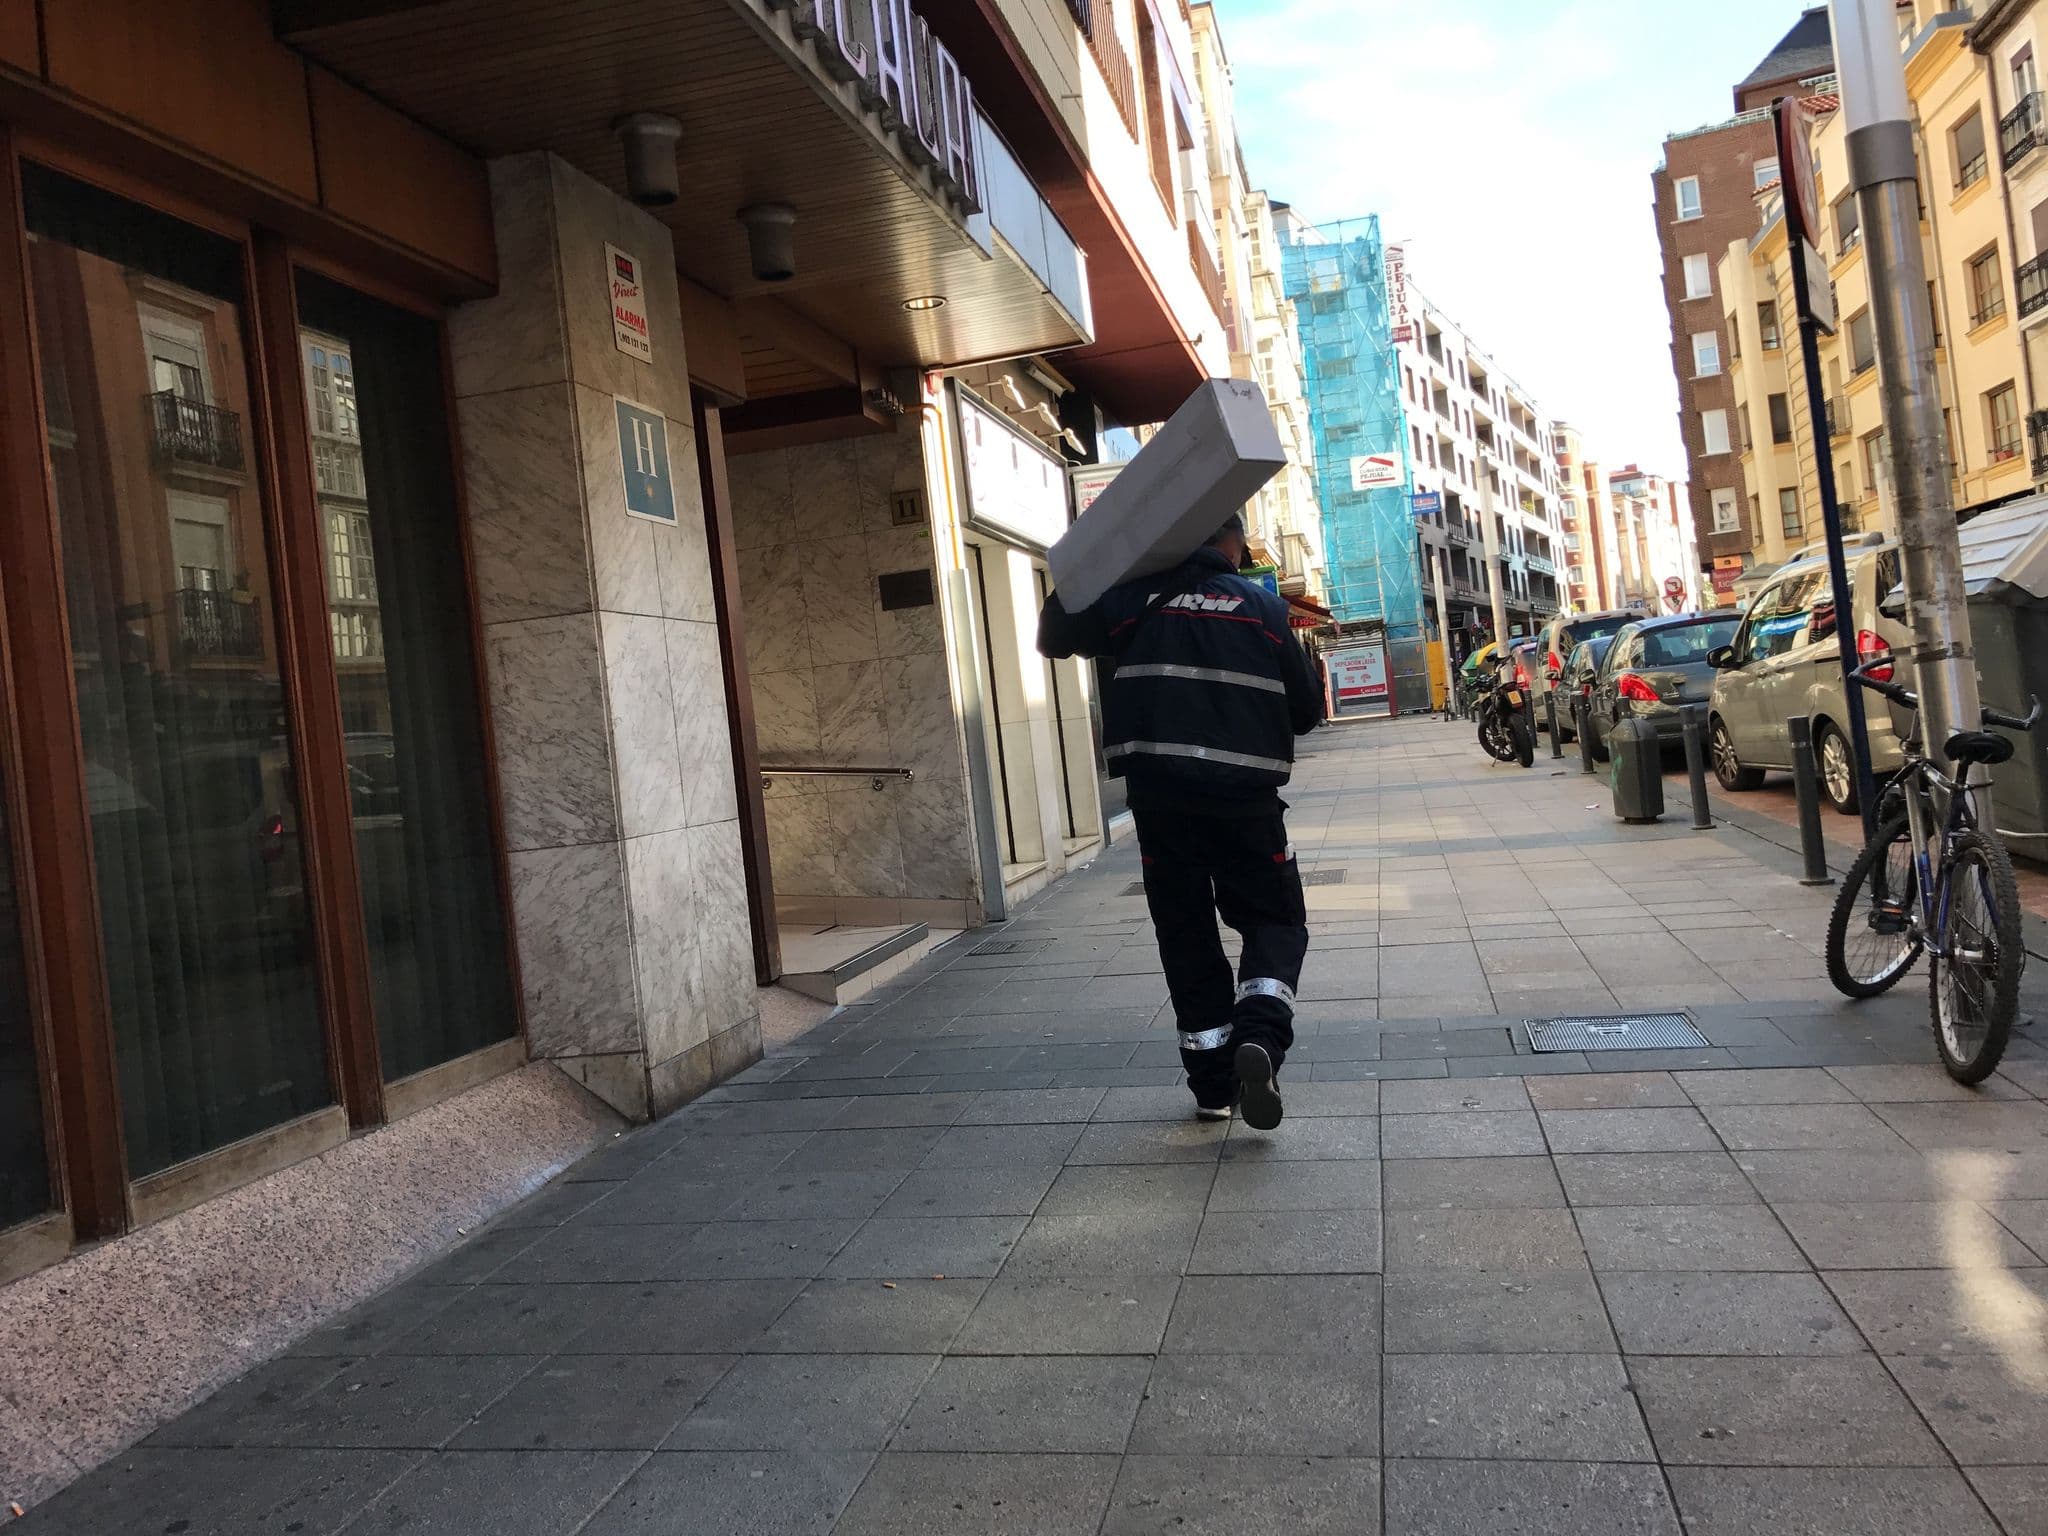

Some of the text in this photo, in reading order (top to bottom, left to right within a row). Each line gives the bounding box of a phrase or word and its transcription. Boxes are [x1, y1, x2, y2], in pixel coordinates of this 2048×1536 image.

[613, 280, 639, 298] Direct
[1394, 262, 1409, 325] PEJUAL
[615, 305, 647, 331] ALARMA
[630, 417, 658, 478] H
[898, 498, 917, 517] 11
